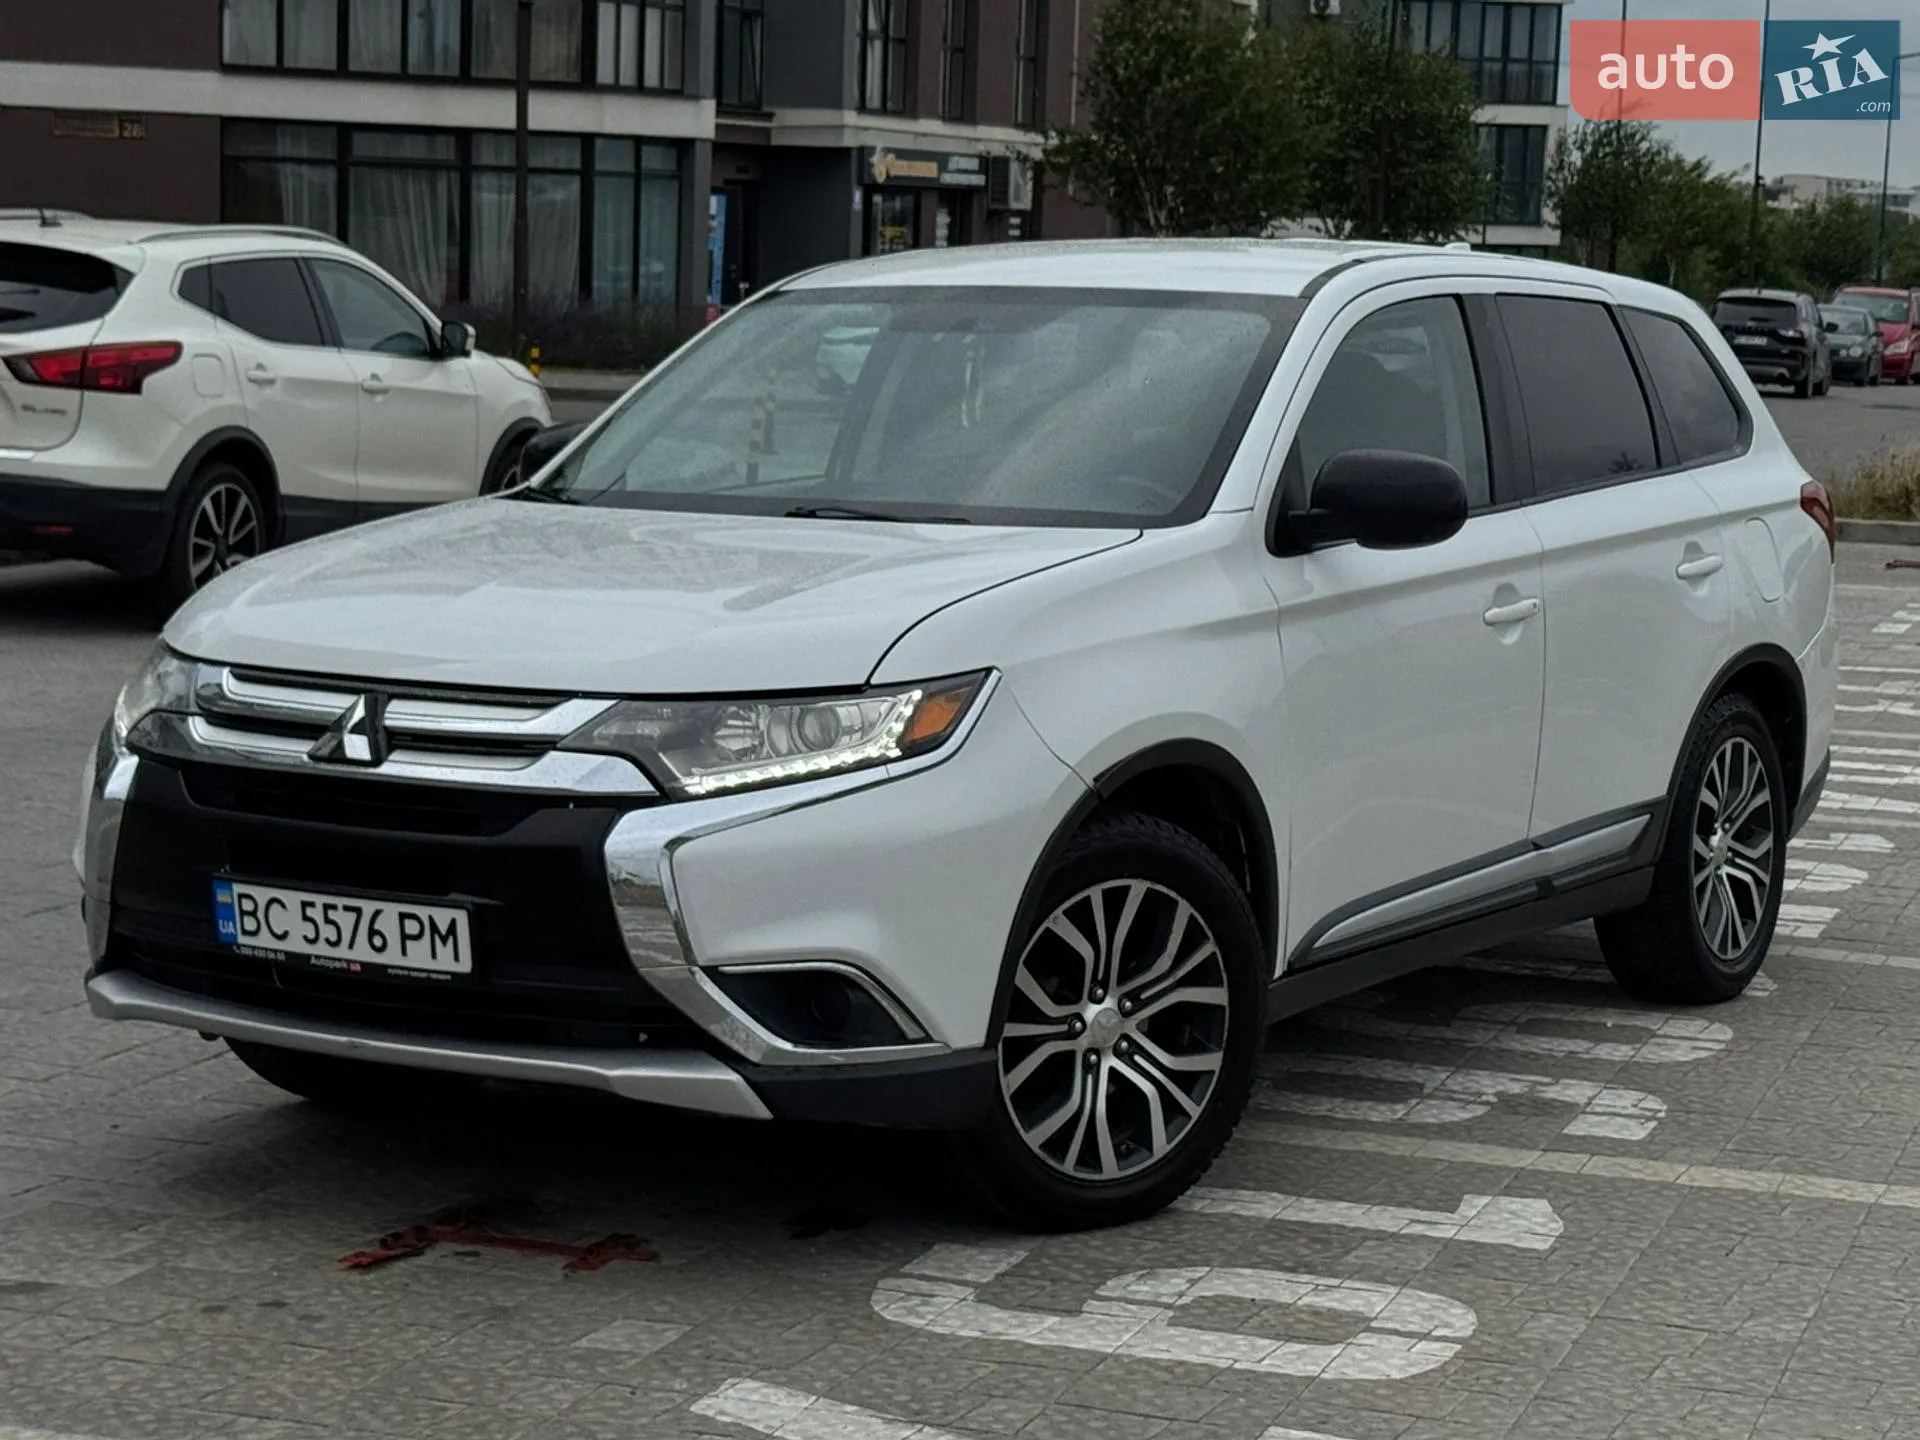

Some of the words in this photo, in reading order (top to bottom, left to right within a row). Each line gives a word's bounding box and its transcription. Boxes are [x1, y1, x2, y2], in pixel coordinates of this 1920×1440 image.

[218, 920, 237, 935] UA
[238, 892, 290, 942] BC
[301, 900, 389, 954] 5576
[398, 911, 461, 963] PM
